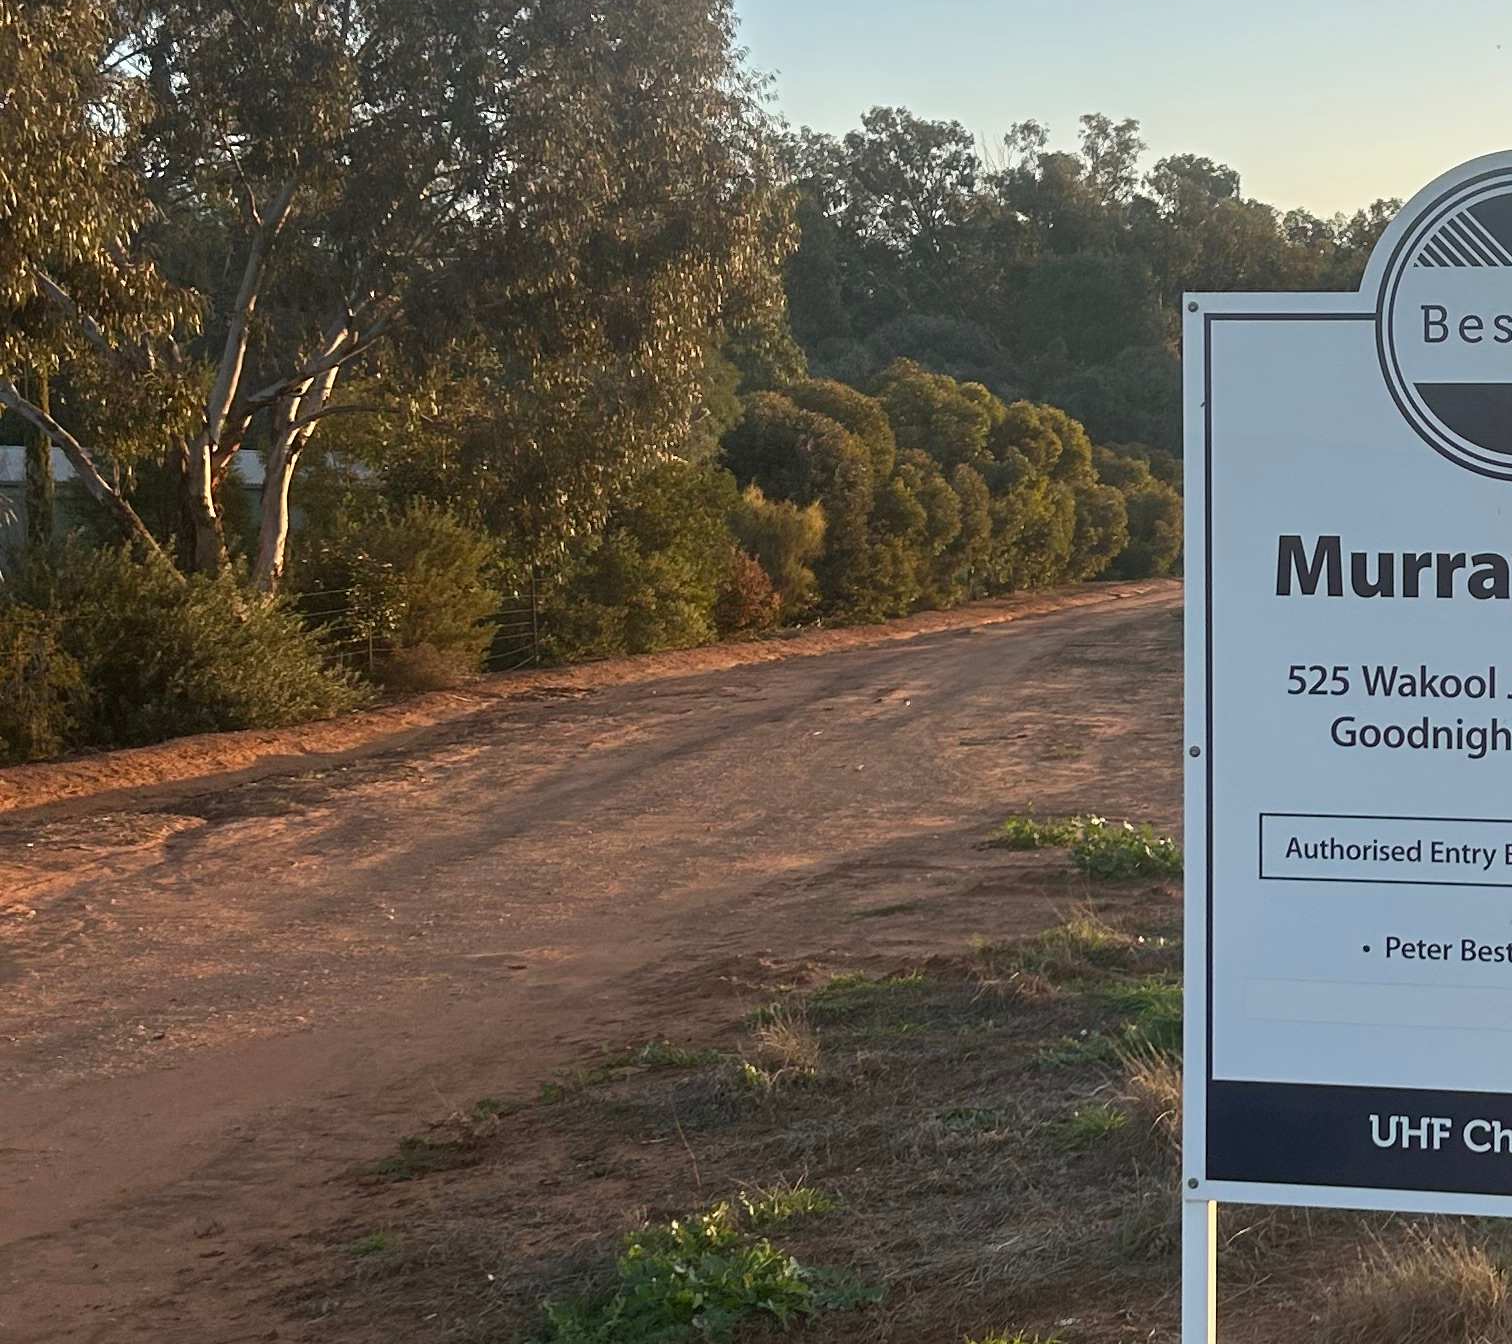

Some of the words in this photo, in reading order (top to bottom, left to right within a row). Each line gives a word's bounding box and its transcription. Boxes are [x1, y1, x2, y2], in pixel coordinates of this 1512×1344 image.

[1287, 664, 1350, 696] 525
[1361, 664, 1496, 699] Wakool
[1285, 836, 1422, 863] Authorised
[1431, 841, 1497, 871] Entry
[1386, 936, 1453, 961] Peter
[1368, 1114, 1452, 1150] UHF
